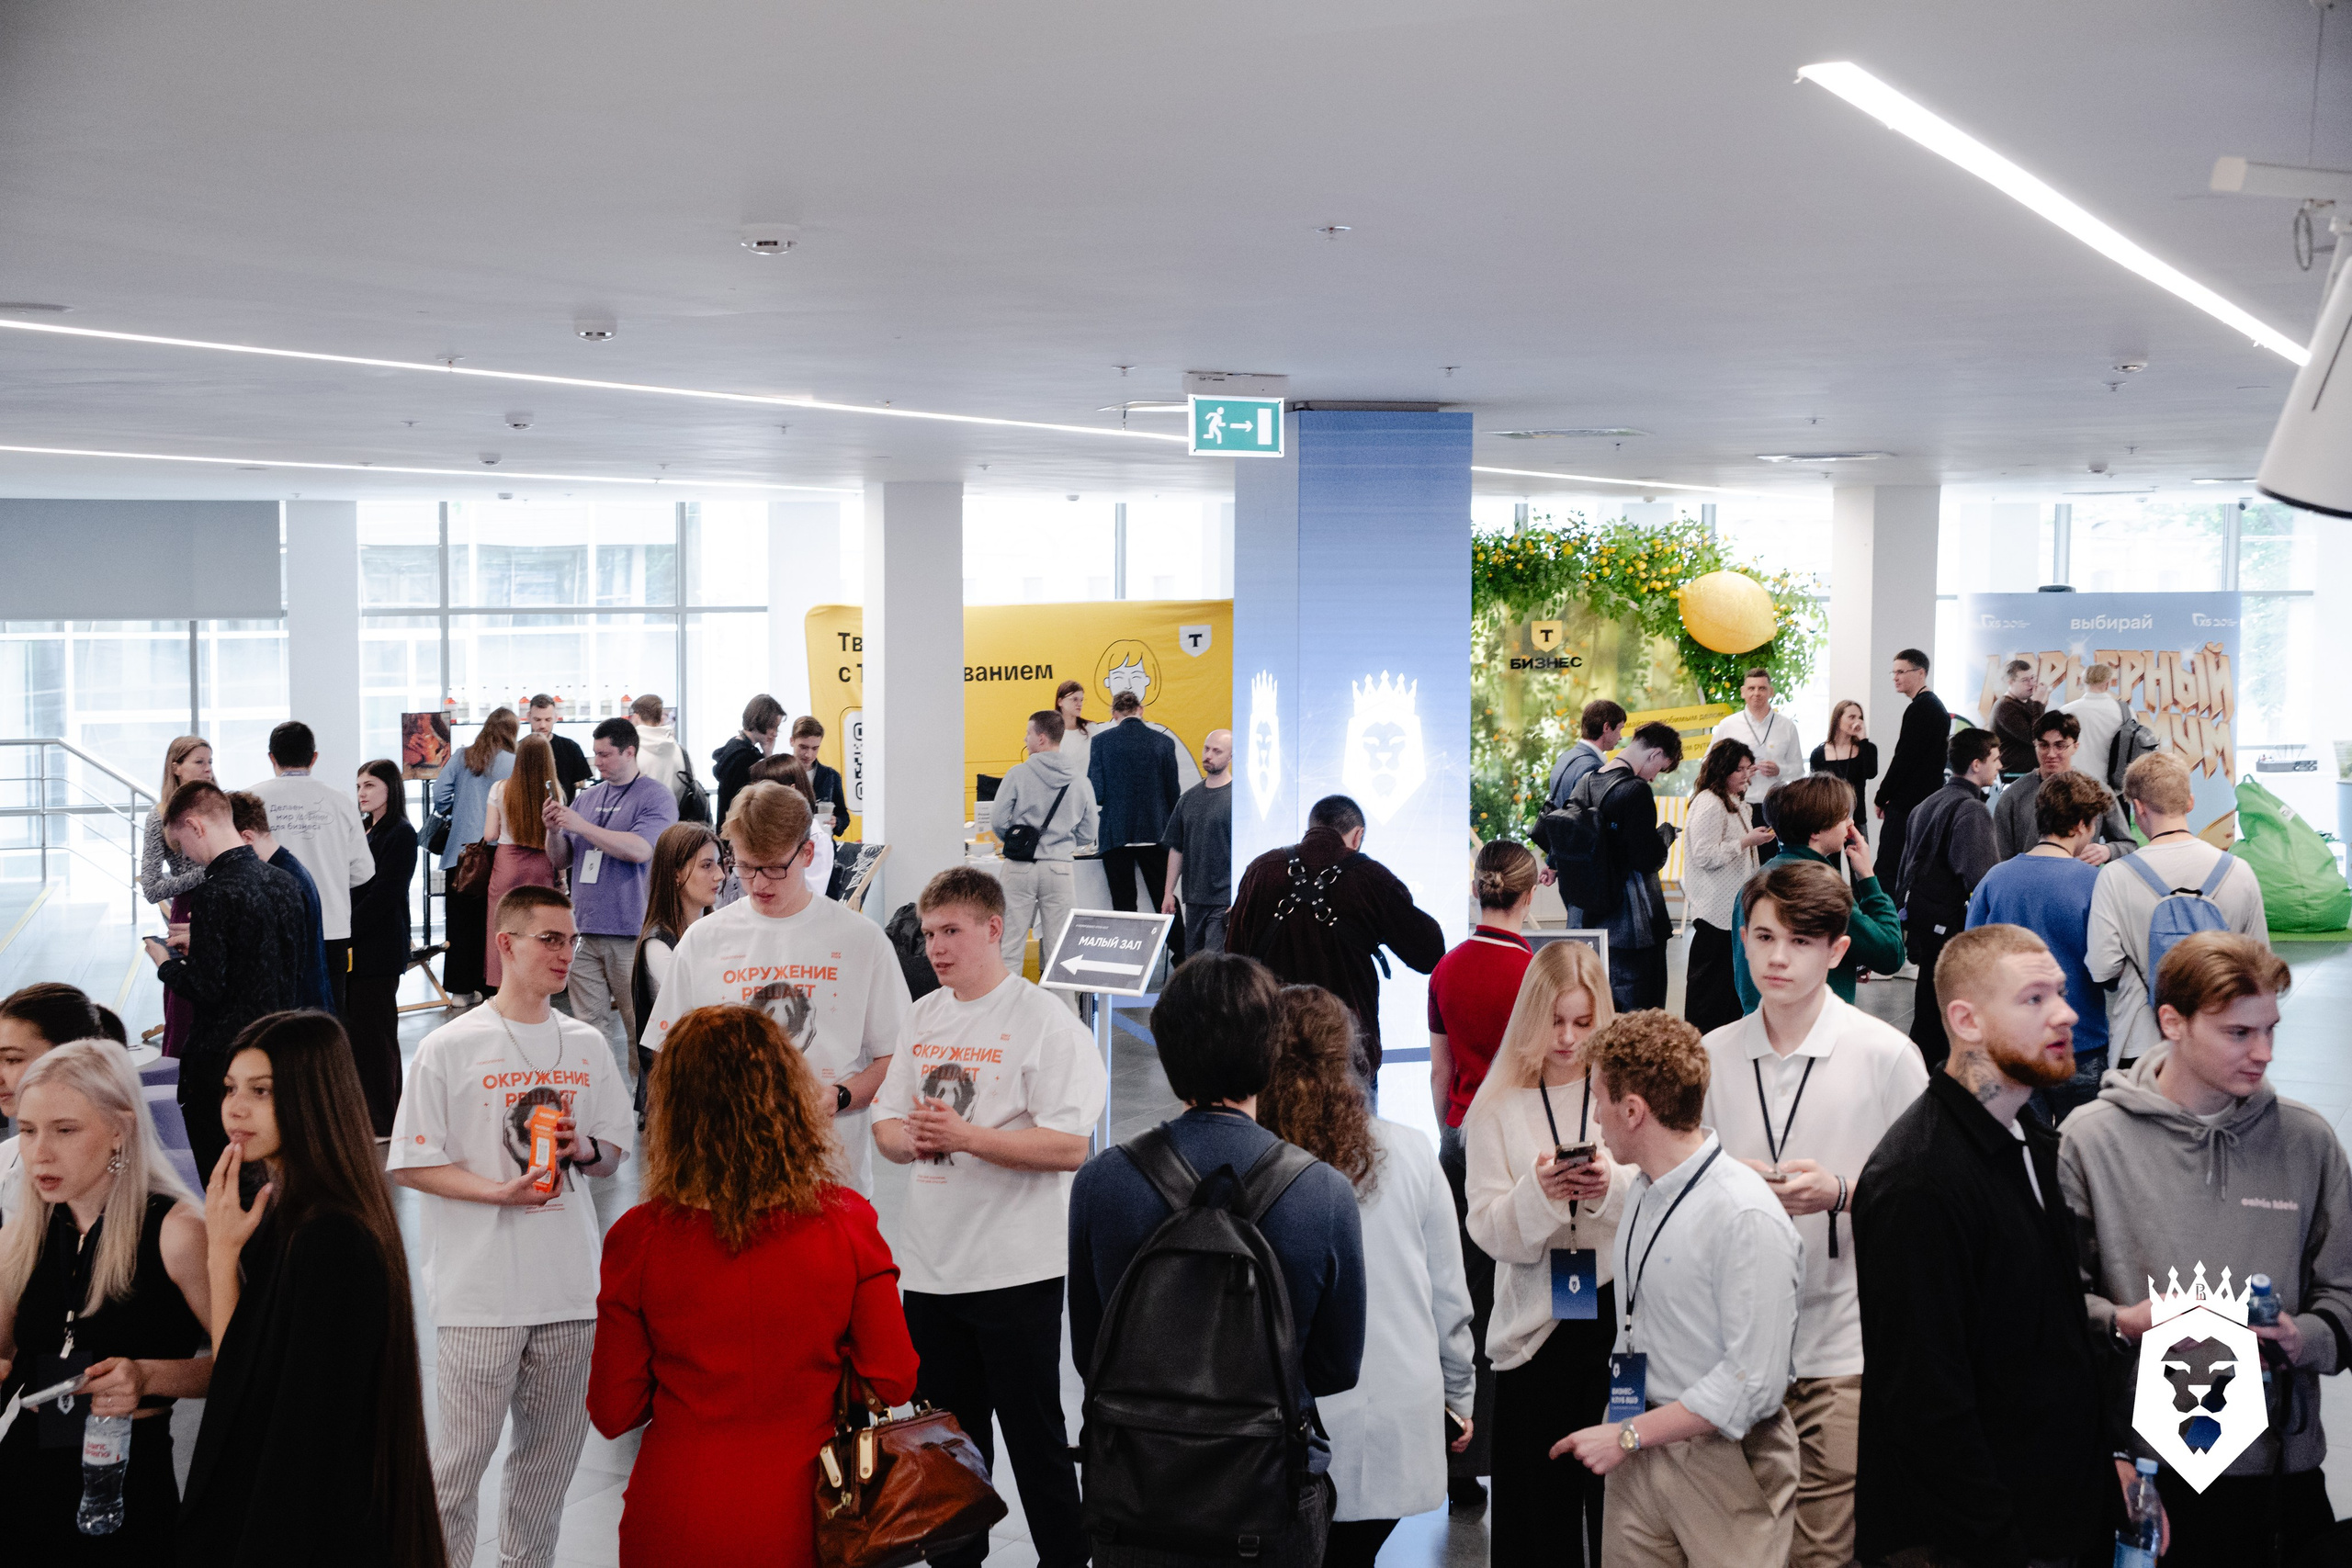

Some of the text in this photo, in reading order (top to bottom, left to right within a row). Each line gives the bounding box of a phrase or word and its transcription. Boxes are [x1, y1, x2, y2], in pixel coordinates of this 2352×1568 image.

[2070, 615, 2153, 632] выбирай
[1510, 656, 1582, 669] БИЗНЕС
[1978, 641, 2234, 726] КРЬЕРНЫЙ
[1078, 936, 1142, 951] МАЛЫЙ ЗАЛ
[722, 964, 838, 984] ОКРУЖЕНИЕ
[741, 984, 816, 1001] РЕШАЕТ
[912, 1043, 1003, 1064] ОКРУЖЕНИЕ
[482, 1070, 591, 1089] ОКРУЖЕНИЕ
[921, 1064, 980, 1082] РЕШАЕТ
